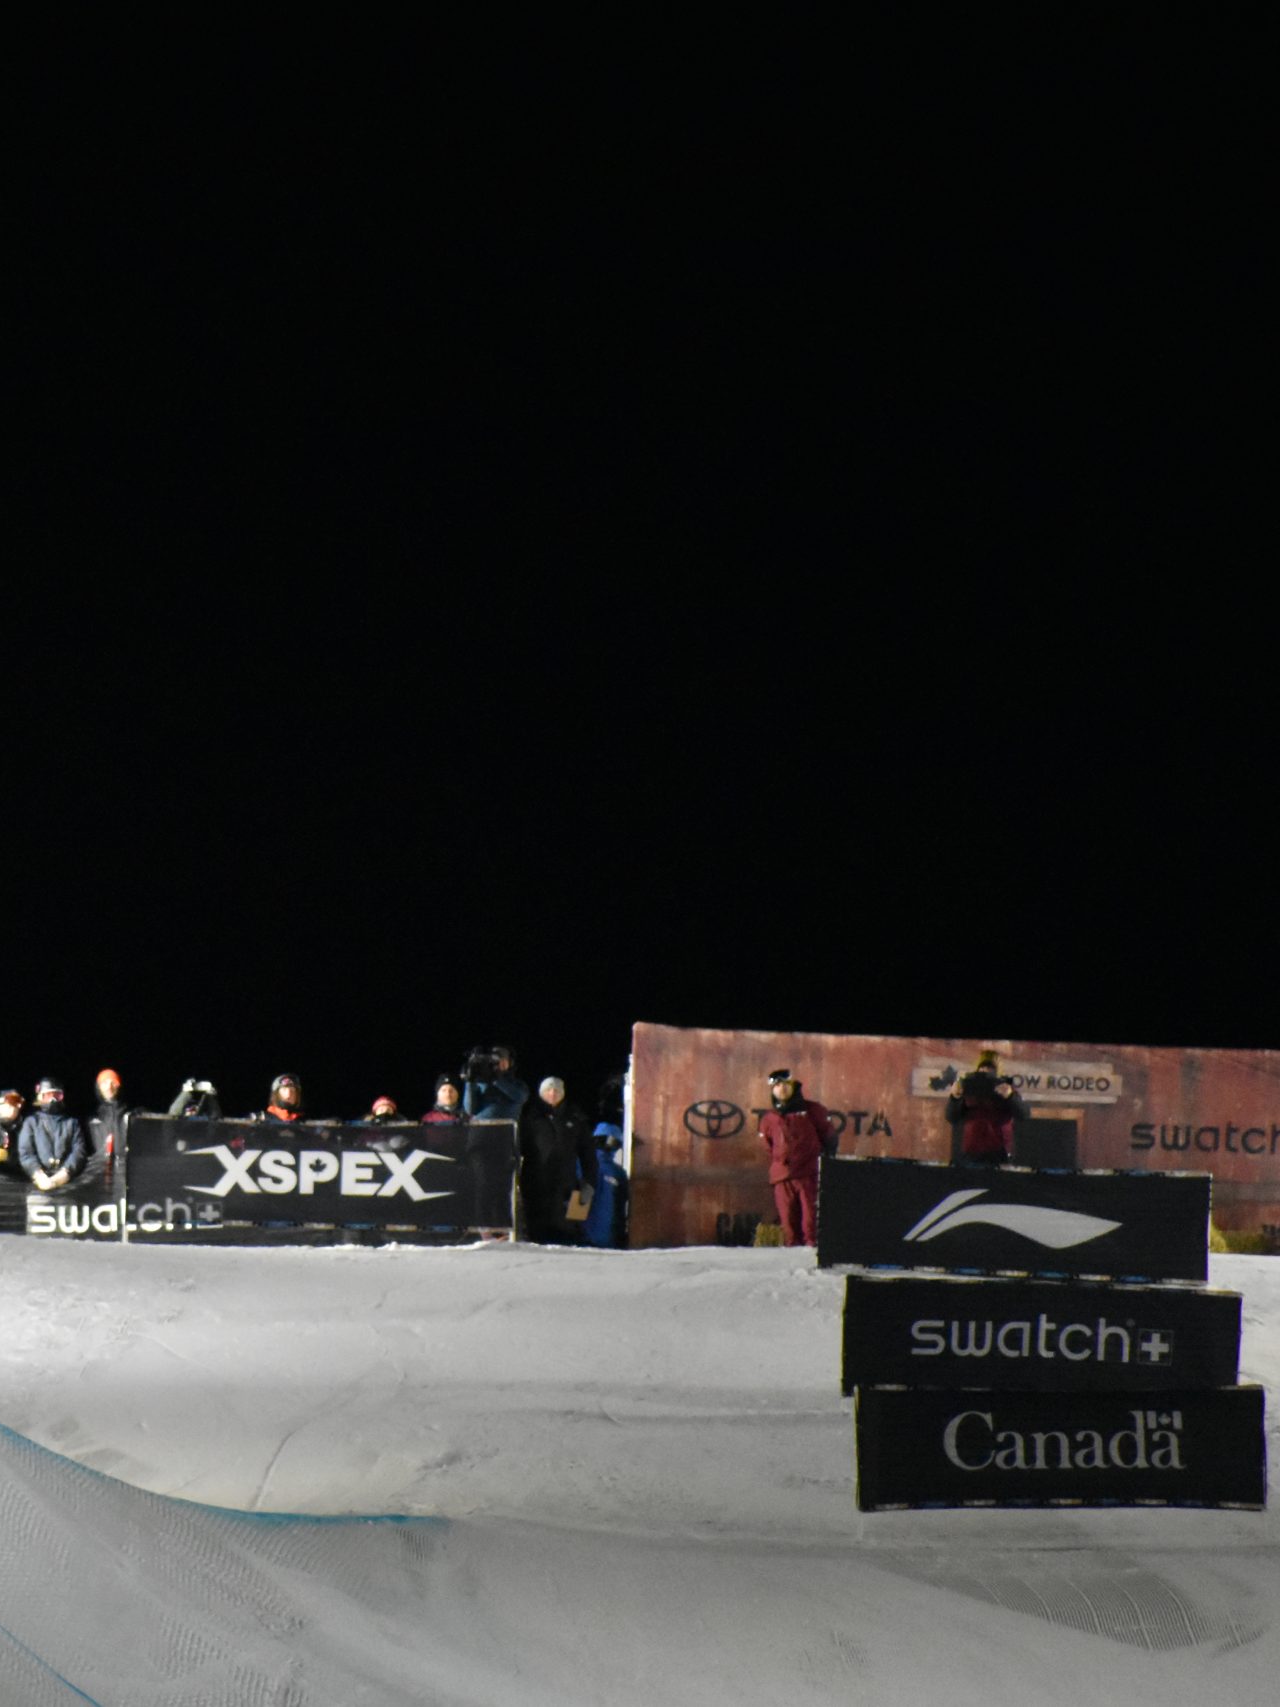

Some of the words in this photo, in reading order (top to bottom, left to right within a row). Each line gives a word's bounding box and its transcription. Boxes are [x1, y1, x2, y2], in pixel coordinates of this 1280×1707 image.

[1047, 1076, 1110, 1091] RODEO
[183, 1145, 457, 1202] XSPEX
[910, 1313, 1132, 1363] swatch
[943, 1410, 1187, 1472] Canada
